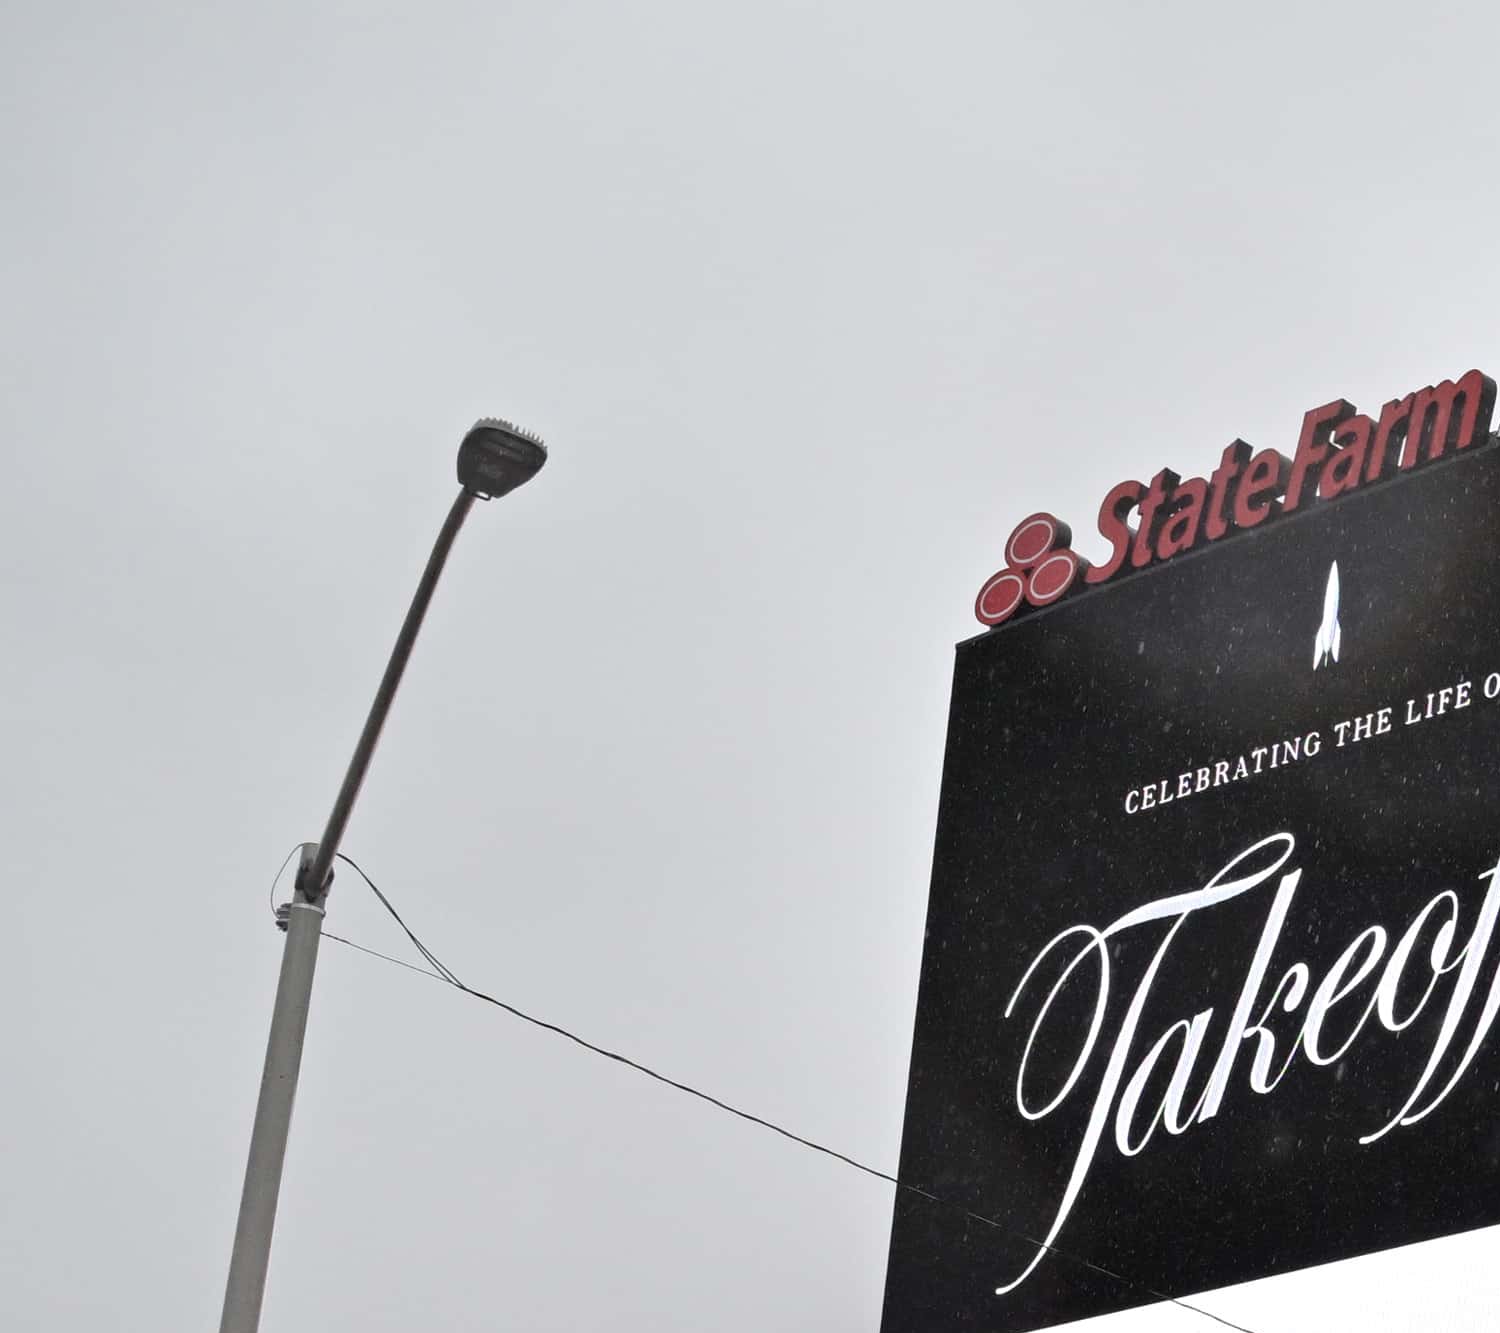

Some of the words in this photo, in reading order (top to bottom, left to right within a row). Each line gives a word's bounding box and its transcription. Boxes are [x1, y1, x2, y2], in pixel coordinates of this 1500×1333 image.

[1123, 731, 1322, 815] CELEBRATING
[1333, 707, 1393, 748] THE
[1404, 681, 1473, 726] LIFE
